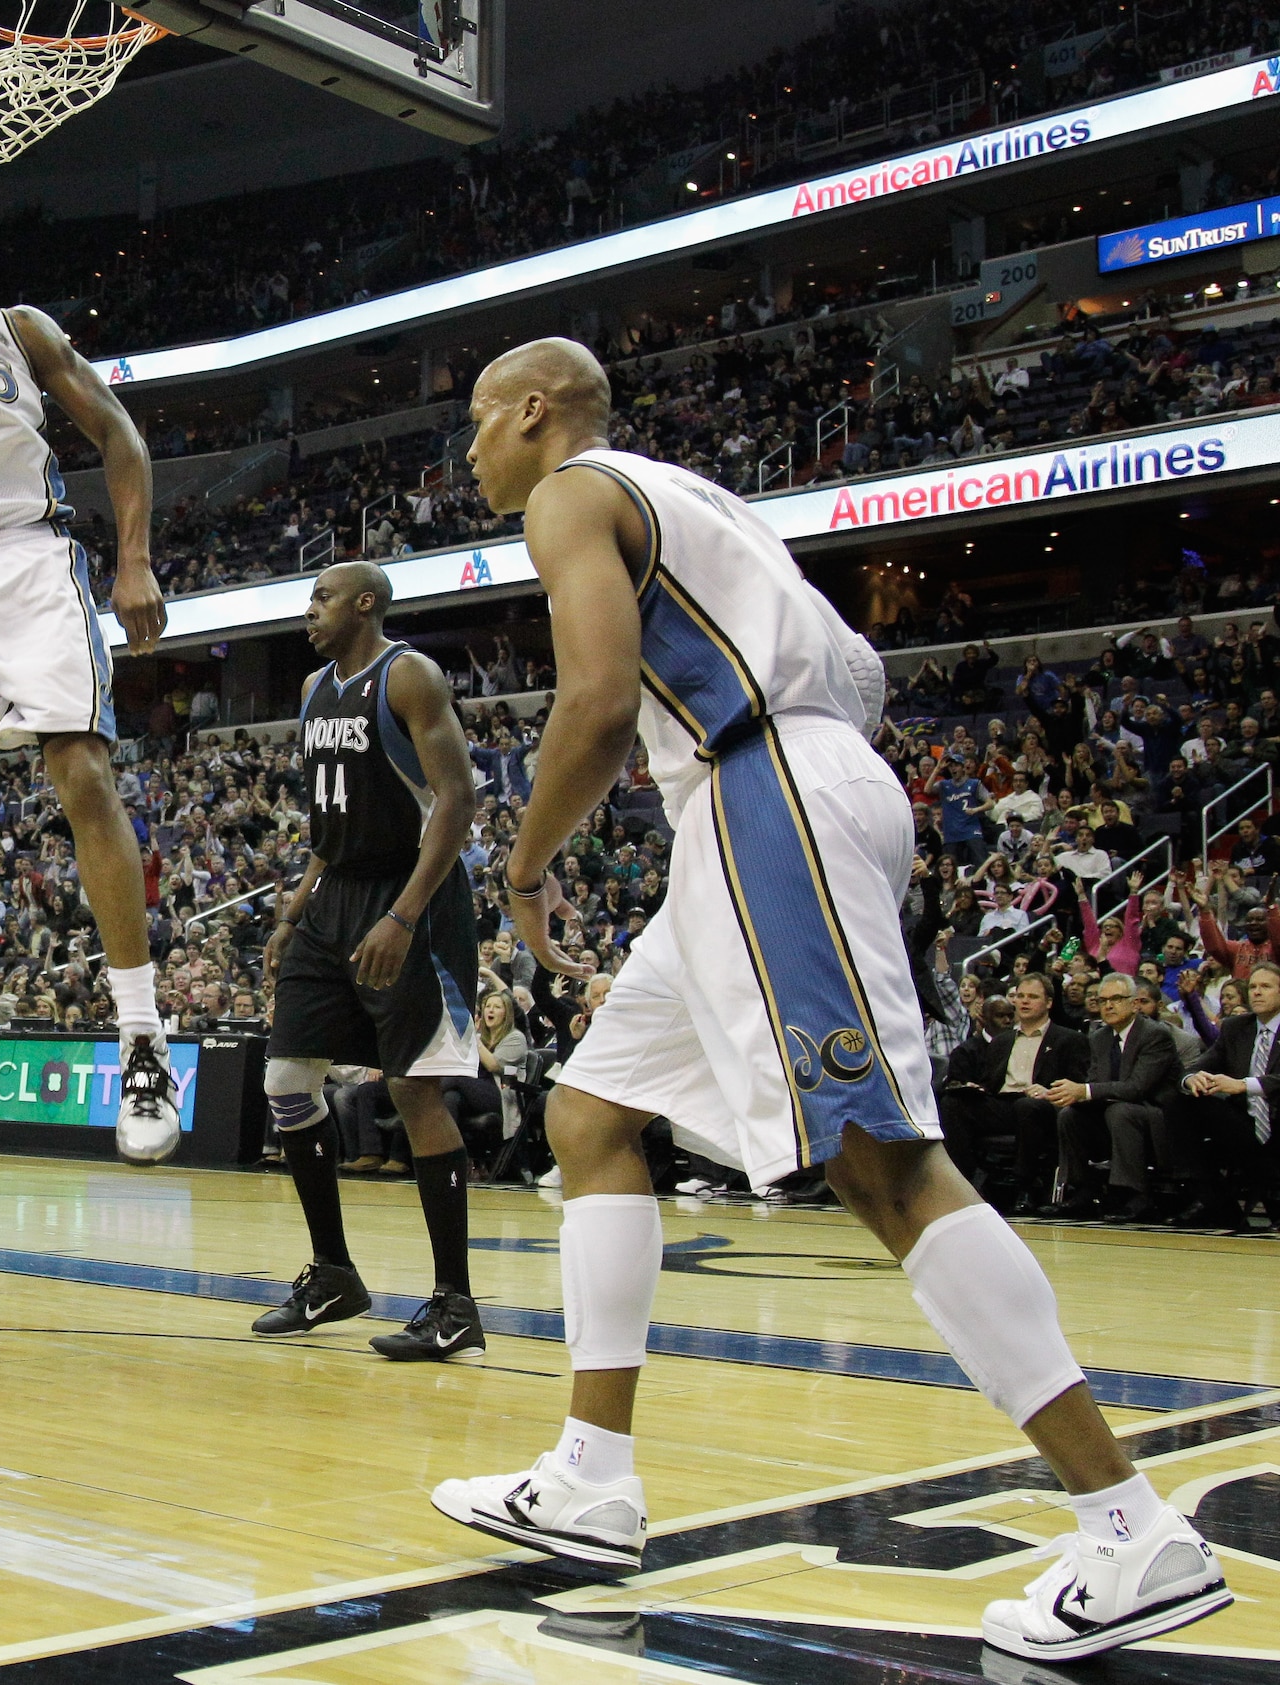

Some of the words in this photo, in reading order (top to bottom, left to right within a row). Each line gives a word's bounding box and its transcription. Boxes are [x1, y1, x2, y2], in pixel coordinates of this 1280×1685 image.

[1001, 263, 1037, 286] 200
[954, 302, 985, 323] 201
[304, 715, 370, 759] WOLVES
[315, 763, 349, 813] 44
